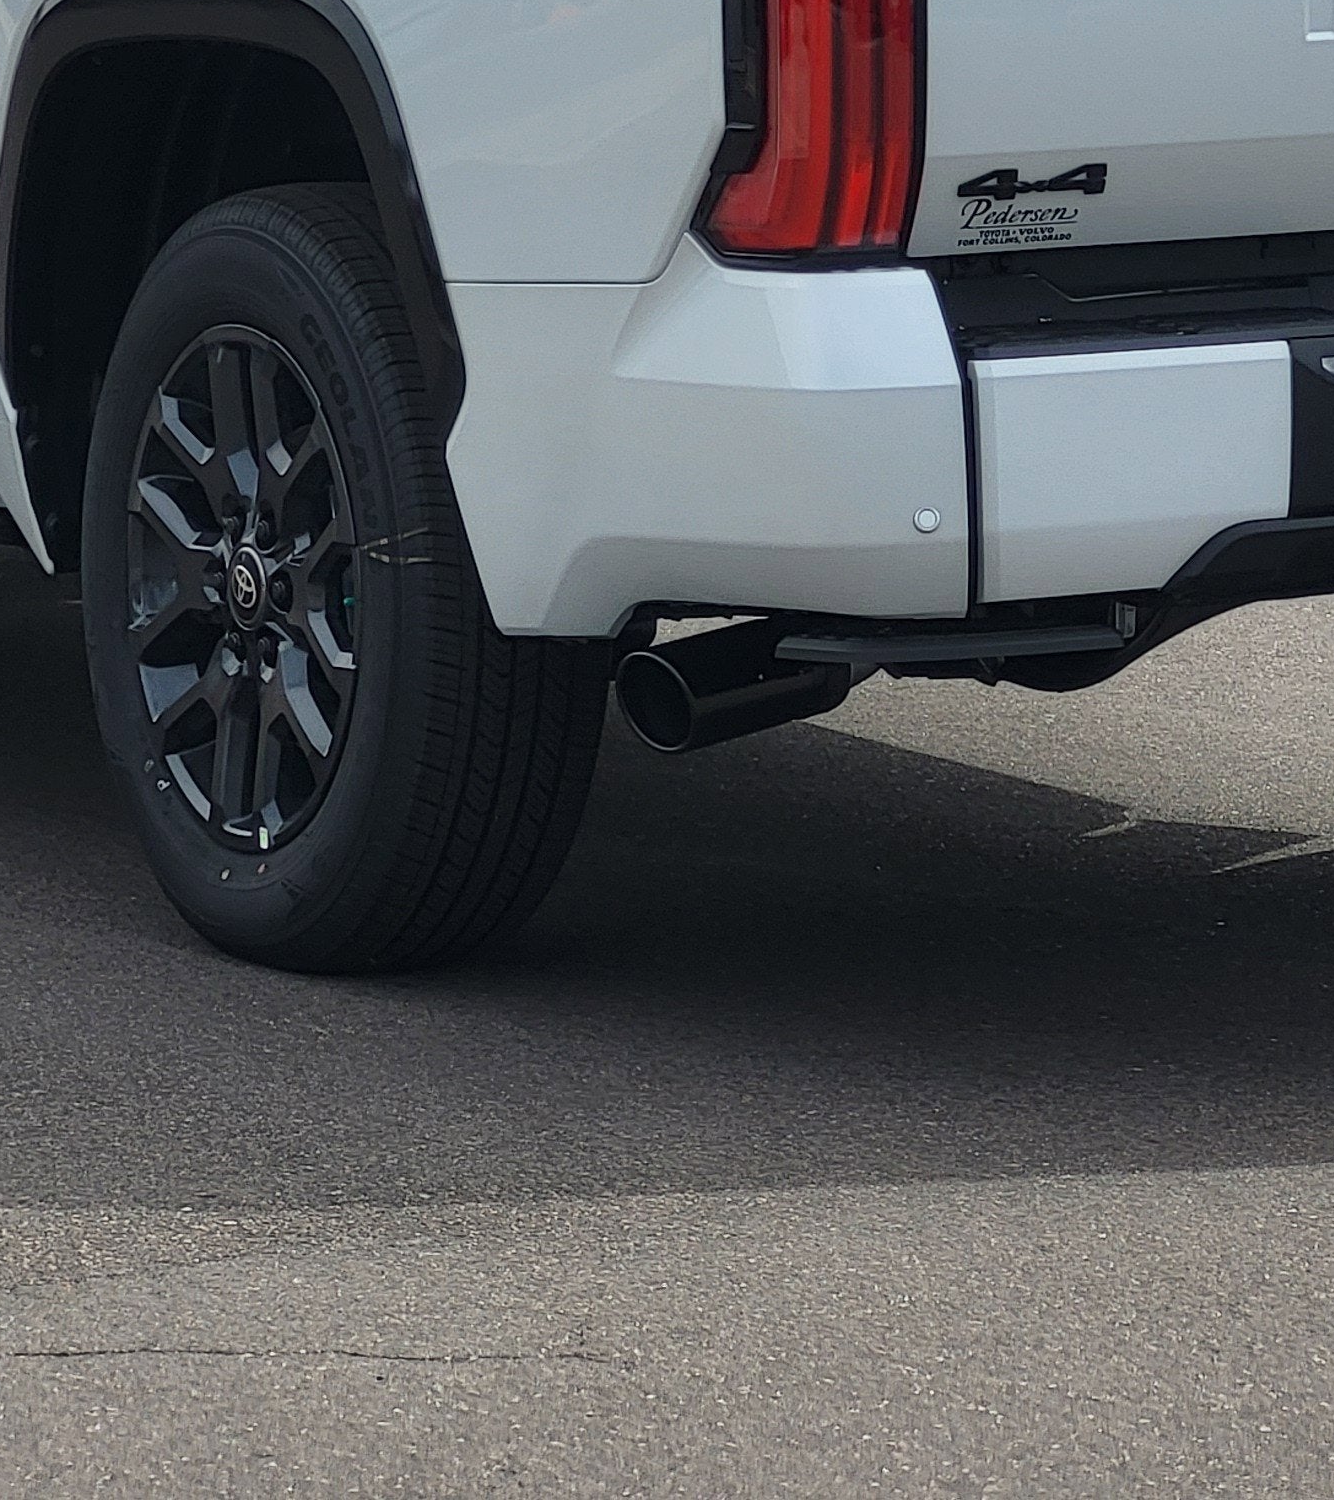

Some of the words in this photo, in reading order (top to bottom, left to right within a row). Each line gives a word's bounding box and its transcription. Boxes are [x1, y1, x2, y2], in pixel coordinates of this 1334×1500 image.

[960, 198, 1079, 230] Pedersen
[979, 229, 1011, 238] TOYOTA
[1019, 227, 1055, 236] VOLVO
[957, 238, 980, 247] FORT
[1024, 233, 1072, 243] COLORADO
